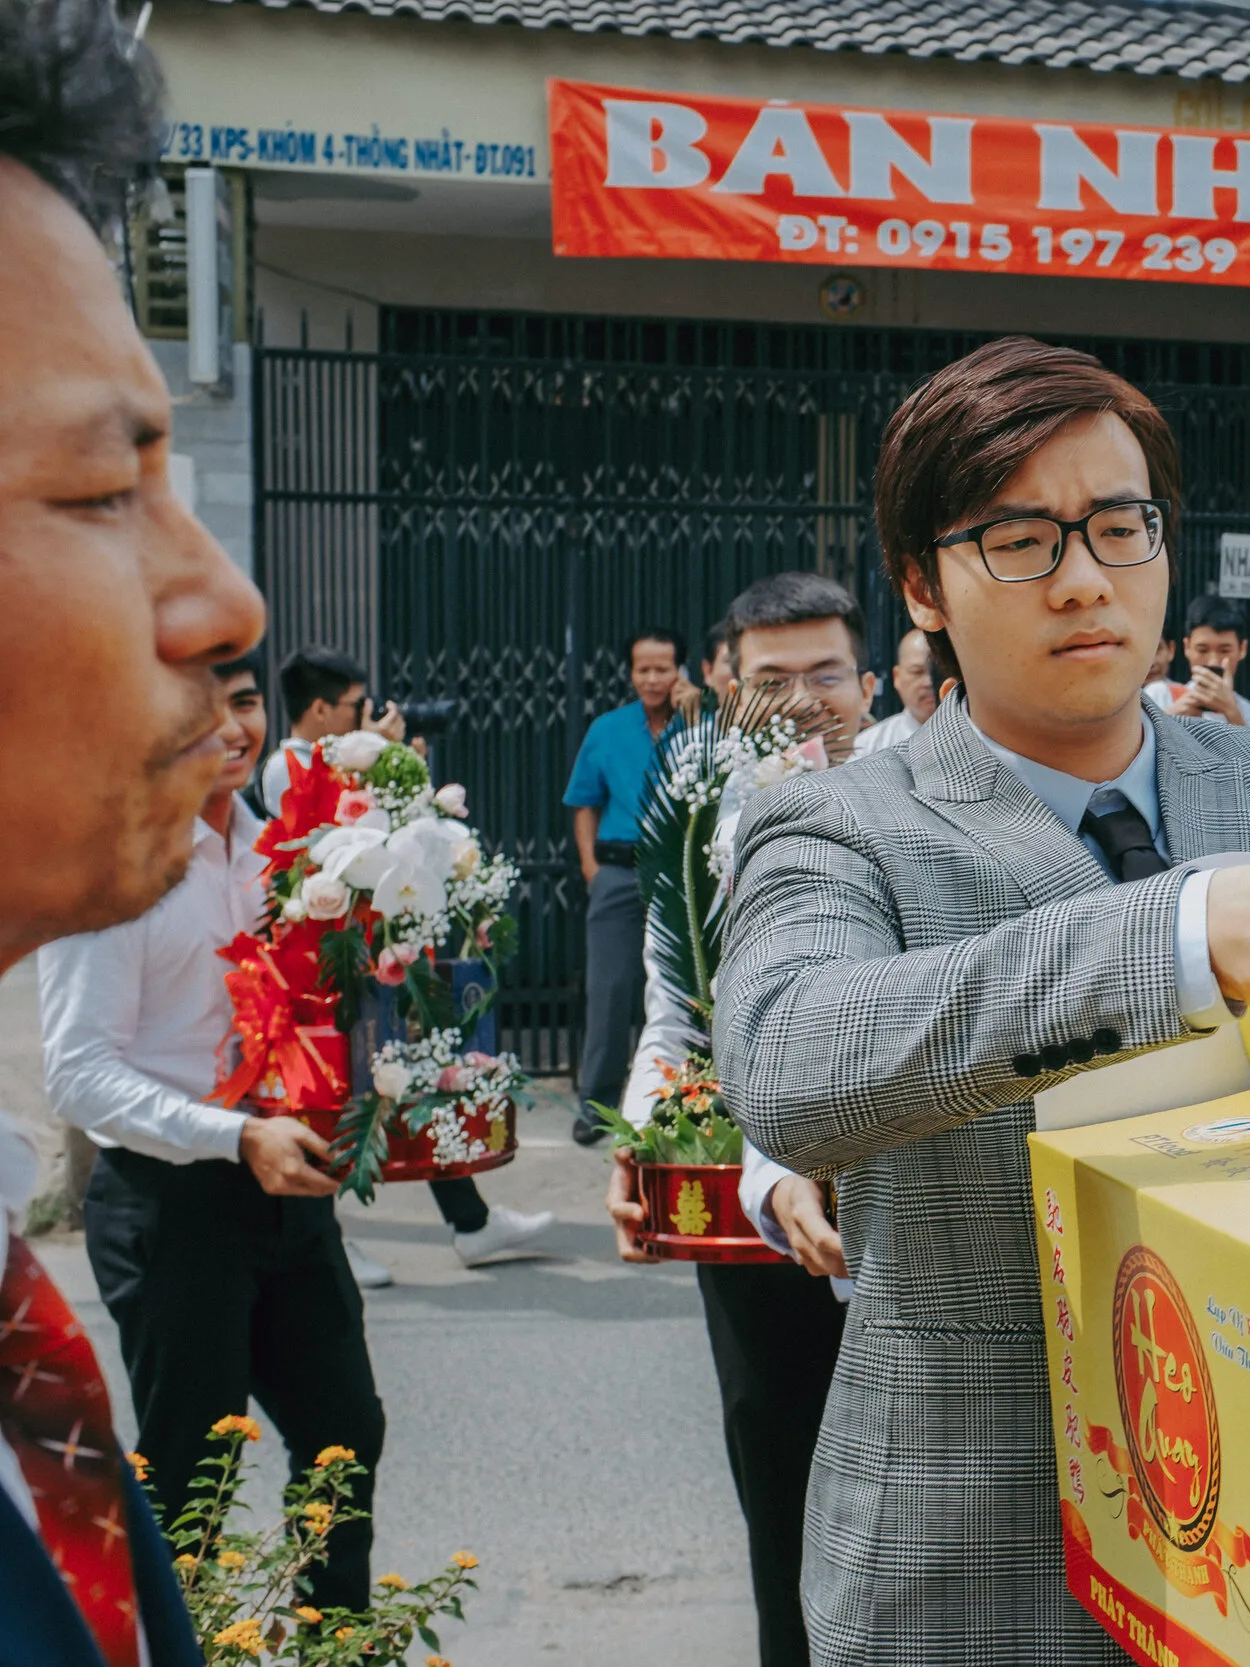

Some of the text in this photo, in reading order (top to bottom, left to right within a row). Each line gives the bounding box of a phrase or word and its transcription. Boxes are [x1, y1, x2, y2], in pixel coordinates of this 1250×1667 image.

[777, 214, 1238, 273] ĐT: 0915 197 239
[1129, 1287, 1198, 1404] Heo
[1139, 1377, 1203, 1508] Quay
[1089, 1574, 1126, 1629] PHÁT
